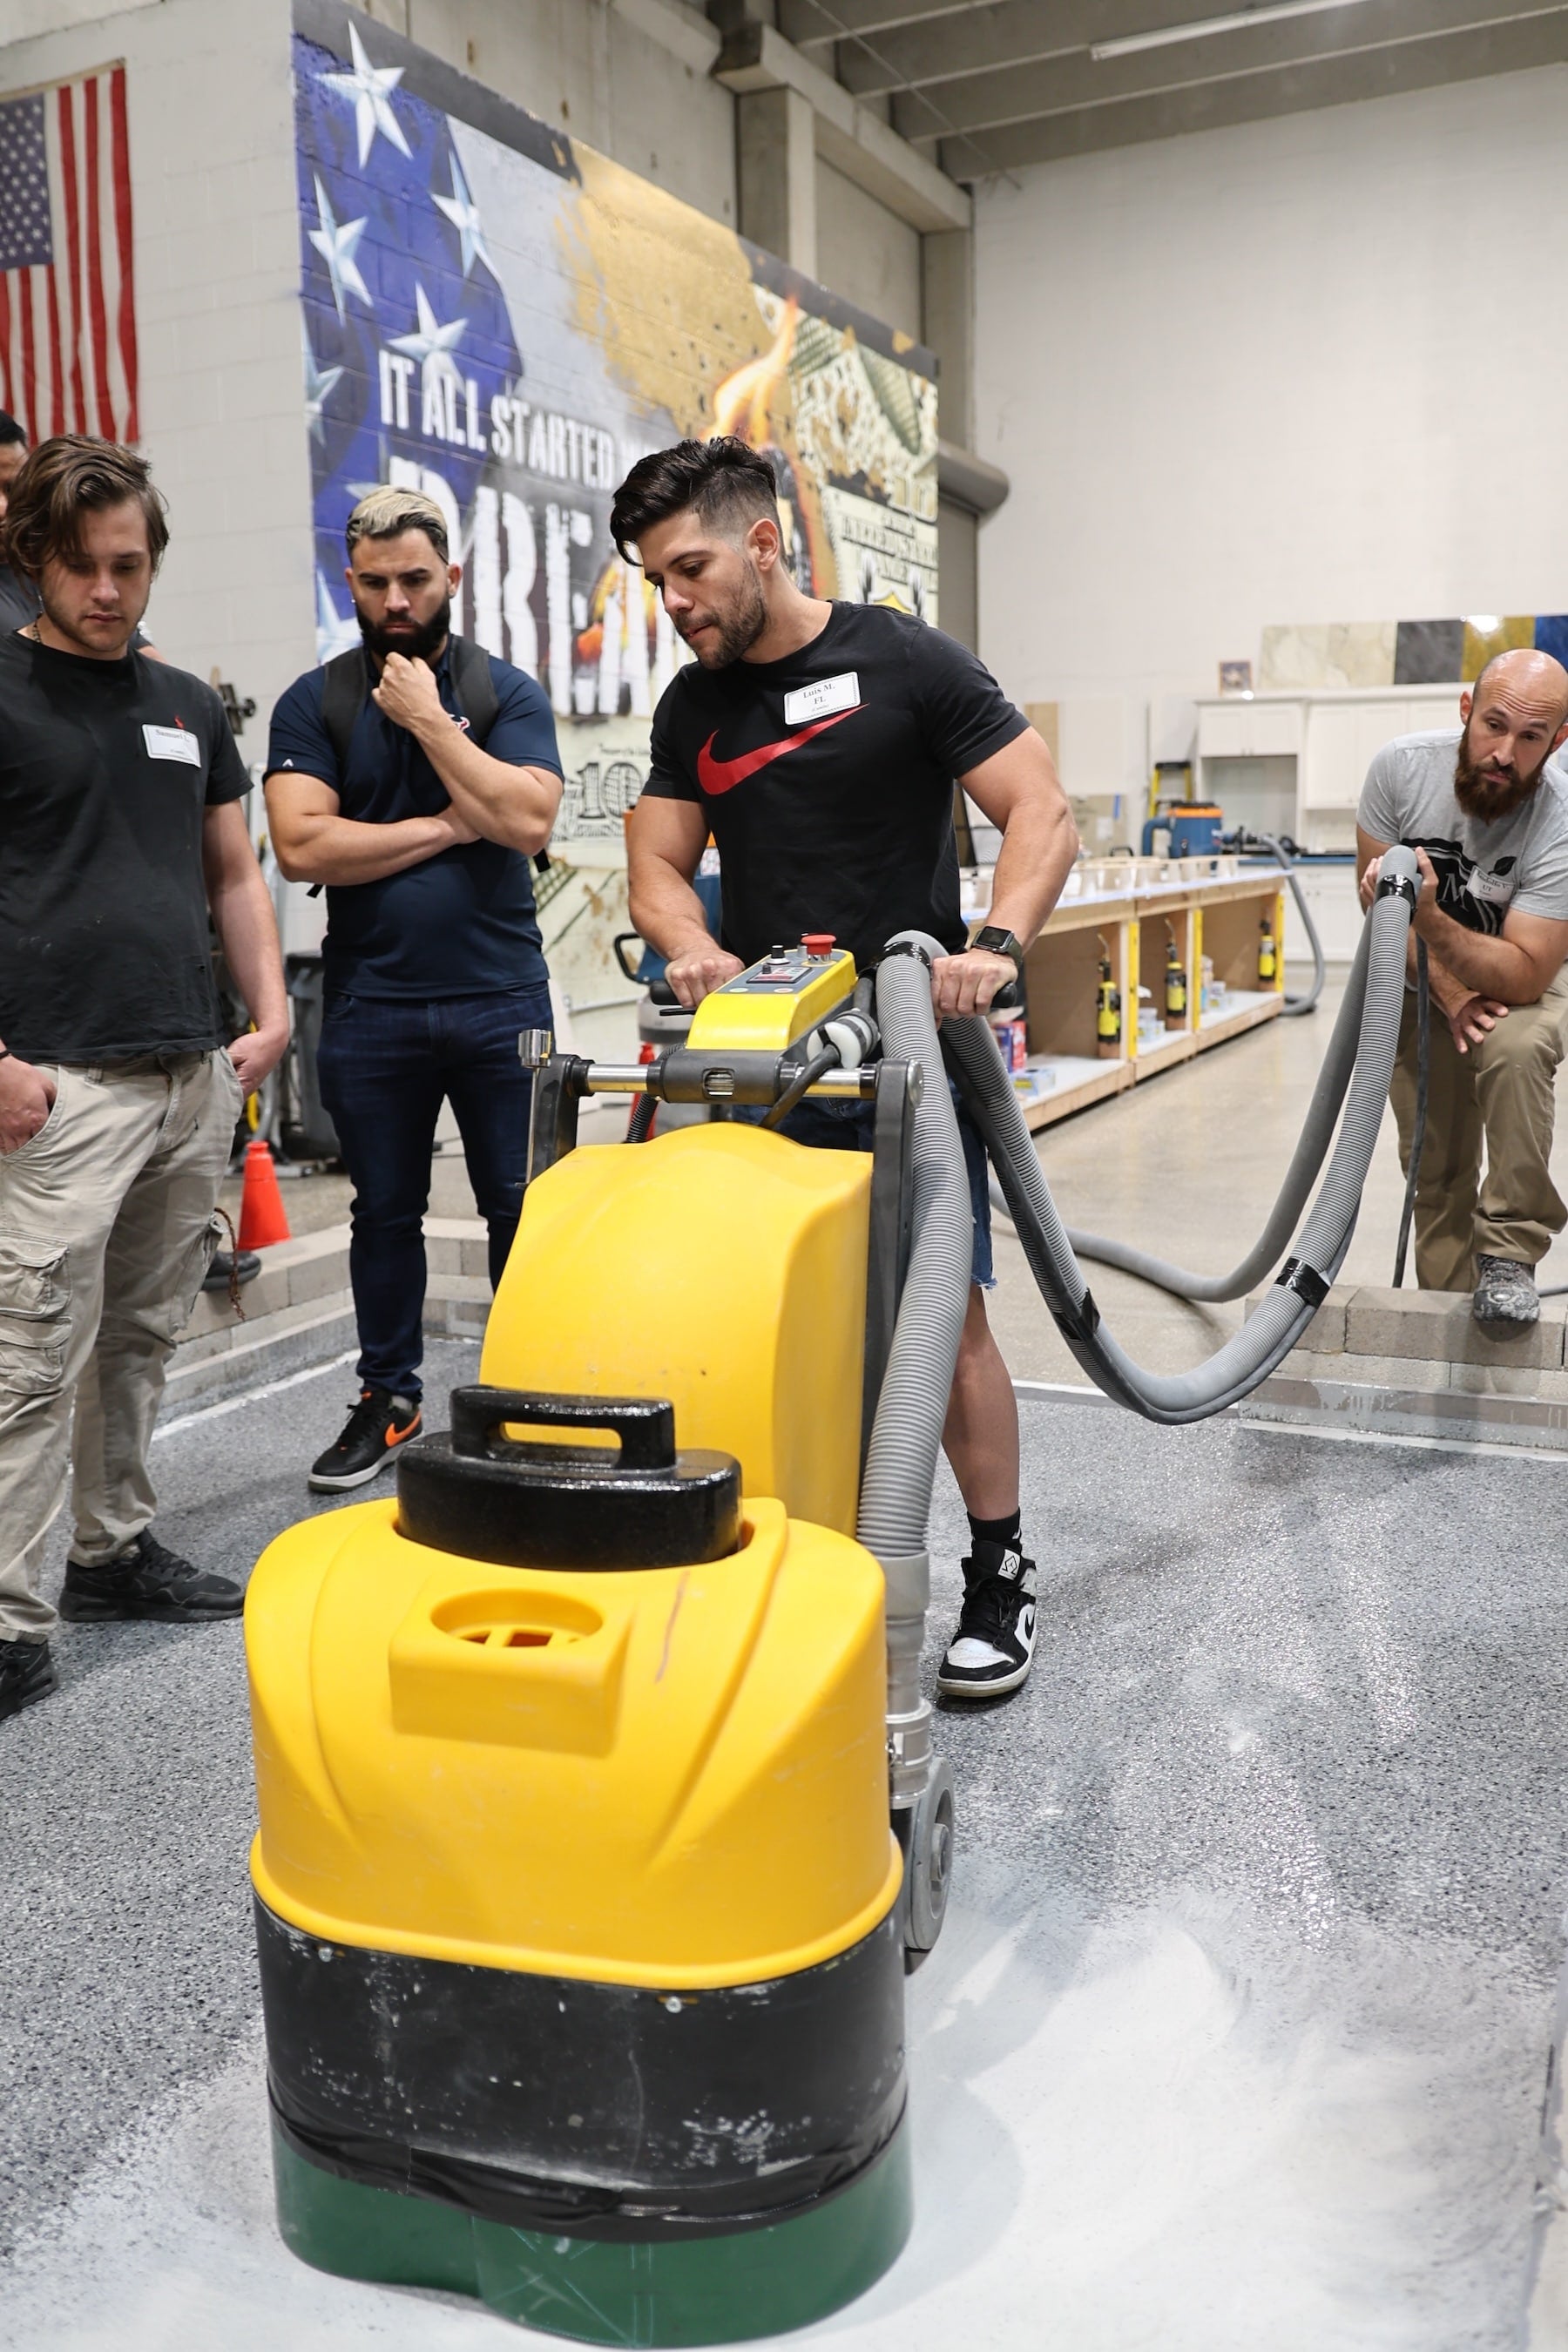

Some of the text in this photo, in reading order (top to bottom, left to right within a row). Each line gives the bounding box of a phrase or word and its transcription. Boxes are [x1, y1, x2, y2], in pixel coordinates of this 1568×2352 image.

[378, 348, 415, 430] IT
[422, 366, 488, 456] ALL
[490, 394, 617, 490] STARTED
[389, 455, 698, 718] DREA
[803, 683, 835, 699] Luis M.
[577, 760, 652, 820] 10
